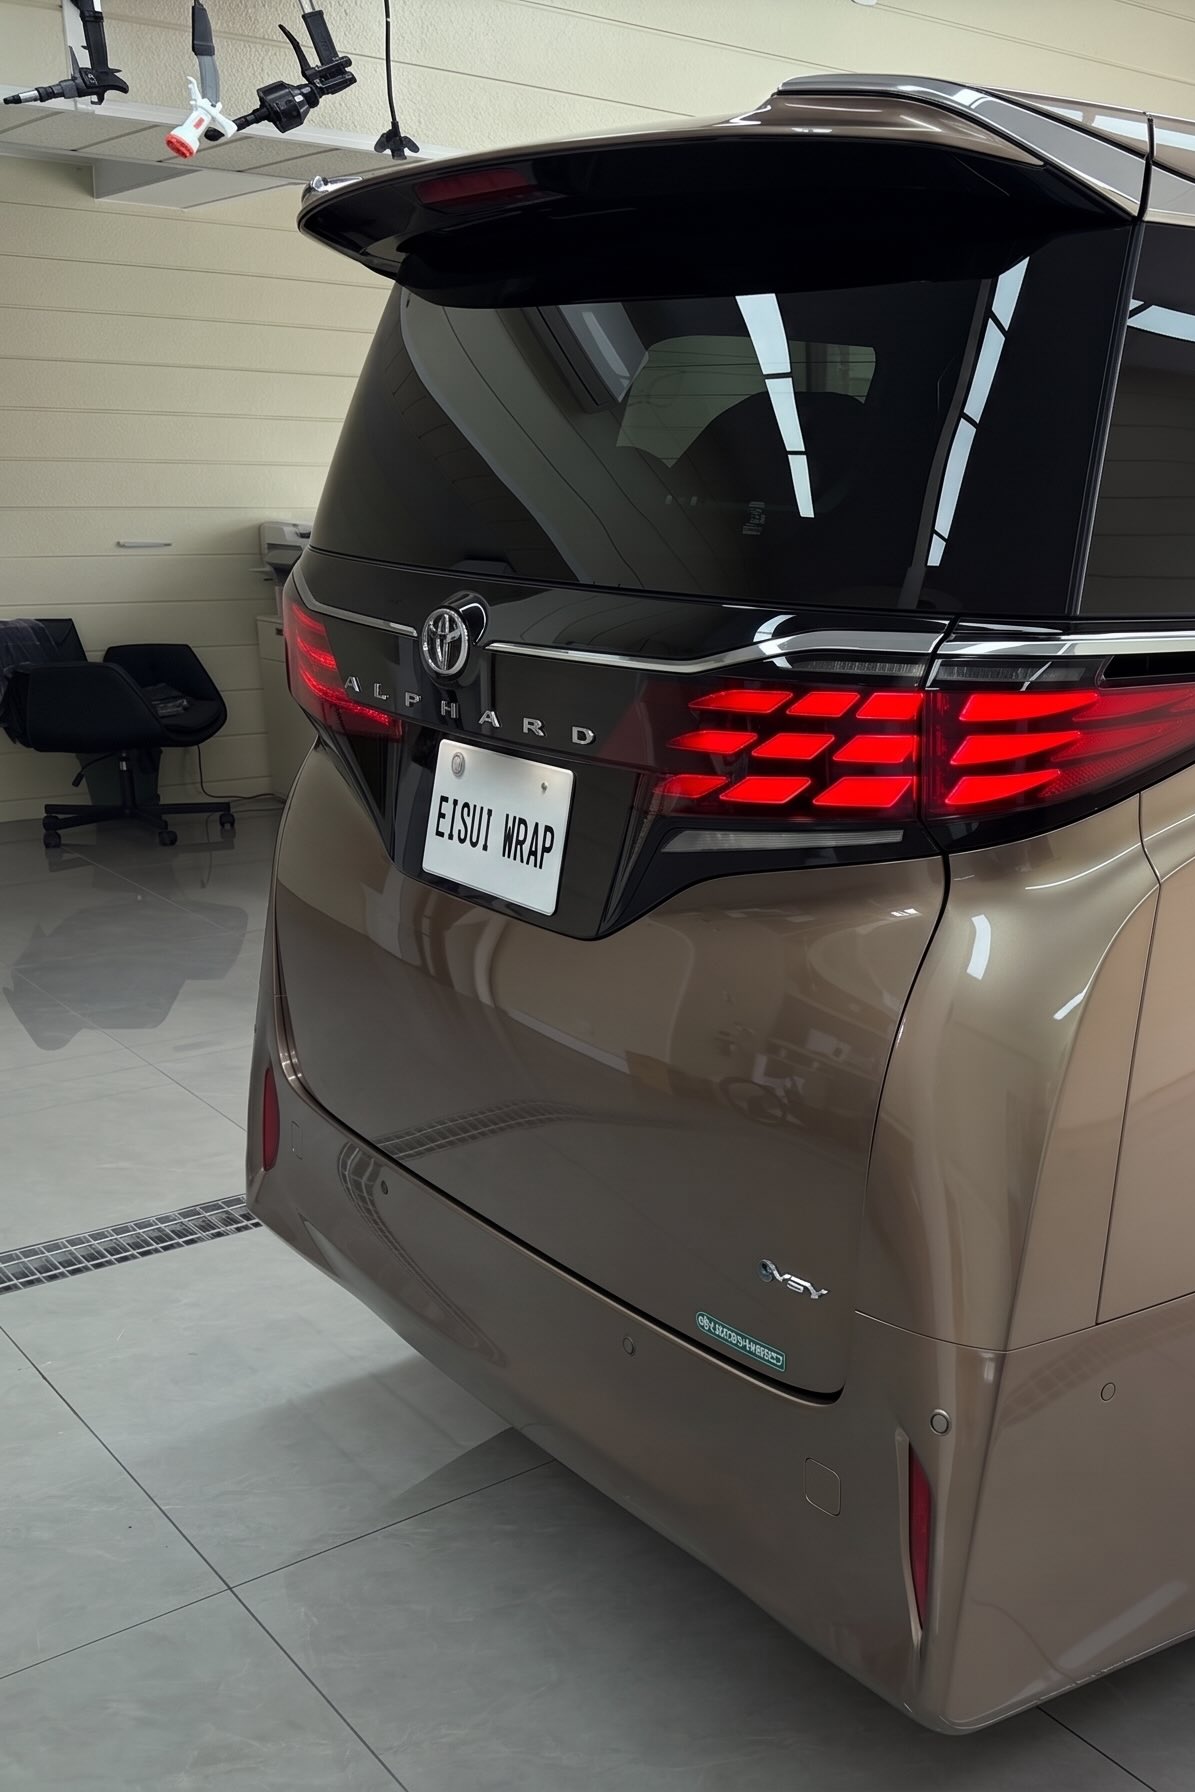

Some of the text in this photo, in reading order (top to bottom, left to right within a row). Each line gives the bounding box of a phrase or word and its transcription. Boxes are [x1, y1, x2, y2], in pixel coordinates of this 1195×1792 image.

[344, 675, 596, 745] ALPHARD
[434, 795, 555, 870] EISUI WRAP
